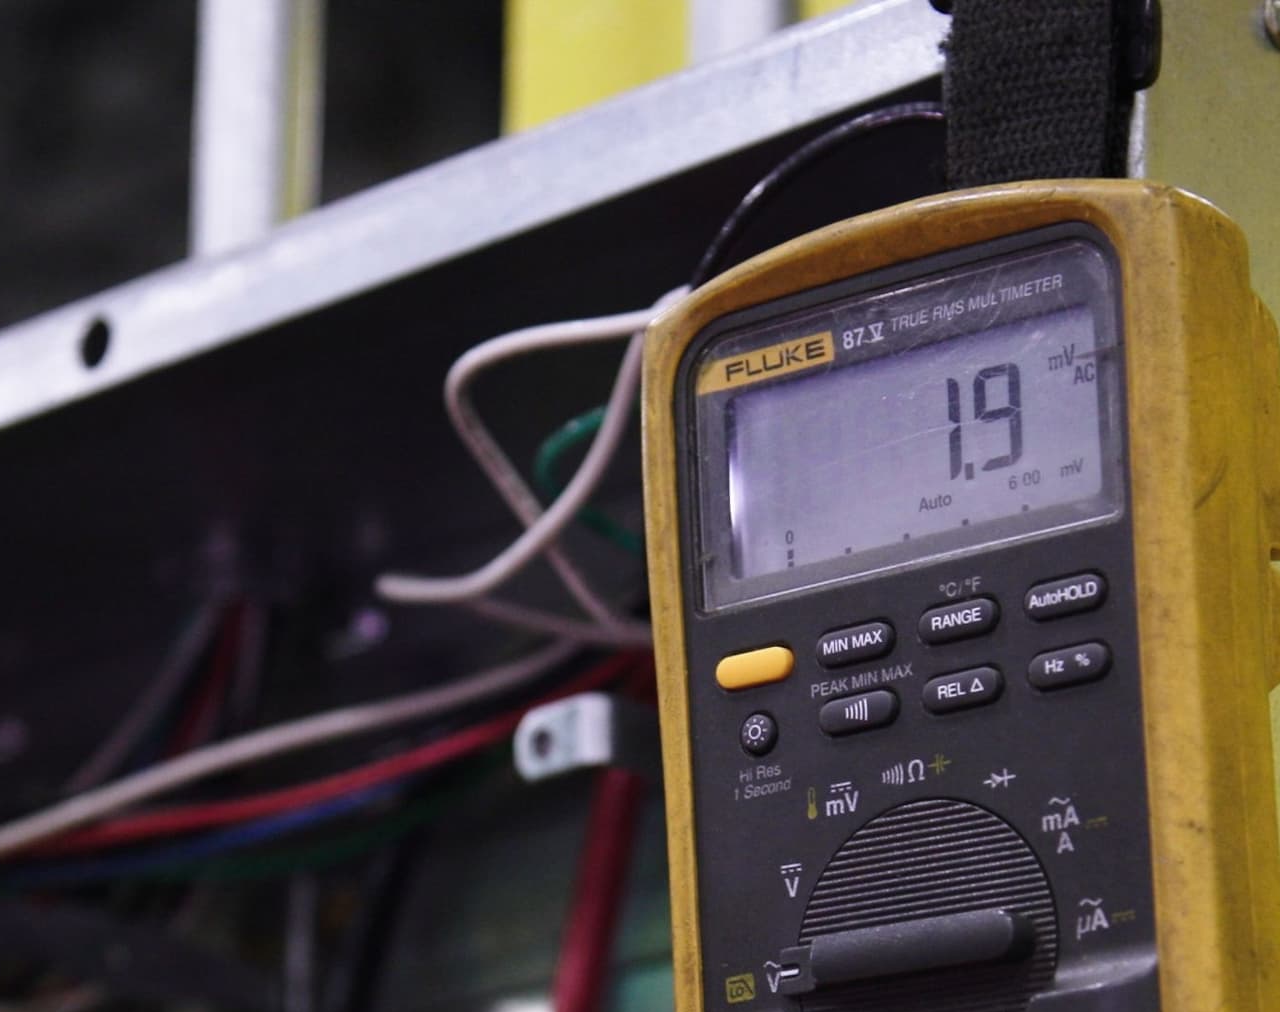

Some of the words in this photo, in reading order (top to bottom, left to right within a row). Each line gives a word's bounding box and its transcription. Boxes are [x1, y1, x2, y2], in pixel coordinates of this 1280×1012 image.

[842, 327, 865, 350] 87
[890, 309, 929, 332] TRUE
[932, 299, 965, 321] RMS
[968, 273, 1063, 310] MULTIMETER
[724, 338, 825, 382] FLUKE
[1048, 344, 1075, 371] mV
[1073, 363, 1096, 385] AC
[946, 362, 1023, 481] 1.9
[1060, 457, 1084, 478] mV
[919, 494, 952, 512] Auto
[785, 530, 794, 545] 0
[1028, 581, 1097, 610] AutoHOLD
[931, 607, 983, 631] RANGE
[823, 637, 849, 656] MIN
[851, 629, 883, 649] MAX
[1044, 658, 1064, 675] Hz
[1074, 652, 1090, 667] %
[810, 677, 849, 698] PEAK
[851, 670, 878, 689] MIN
[881, 661, 913, 682] MAX
[937, 684, 966, 699] REL
[739, 770, 753, 783] Hi
[756, 765, 782, 780] Res
[743, 777, 792, 800] Second
[826, 790, 859, 816] mV
[1042, 805, 1080, 832] mA
[1056, 831, 1074, 854] A
[784, 876, 799, 898] V
